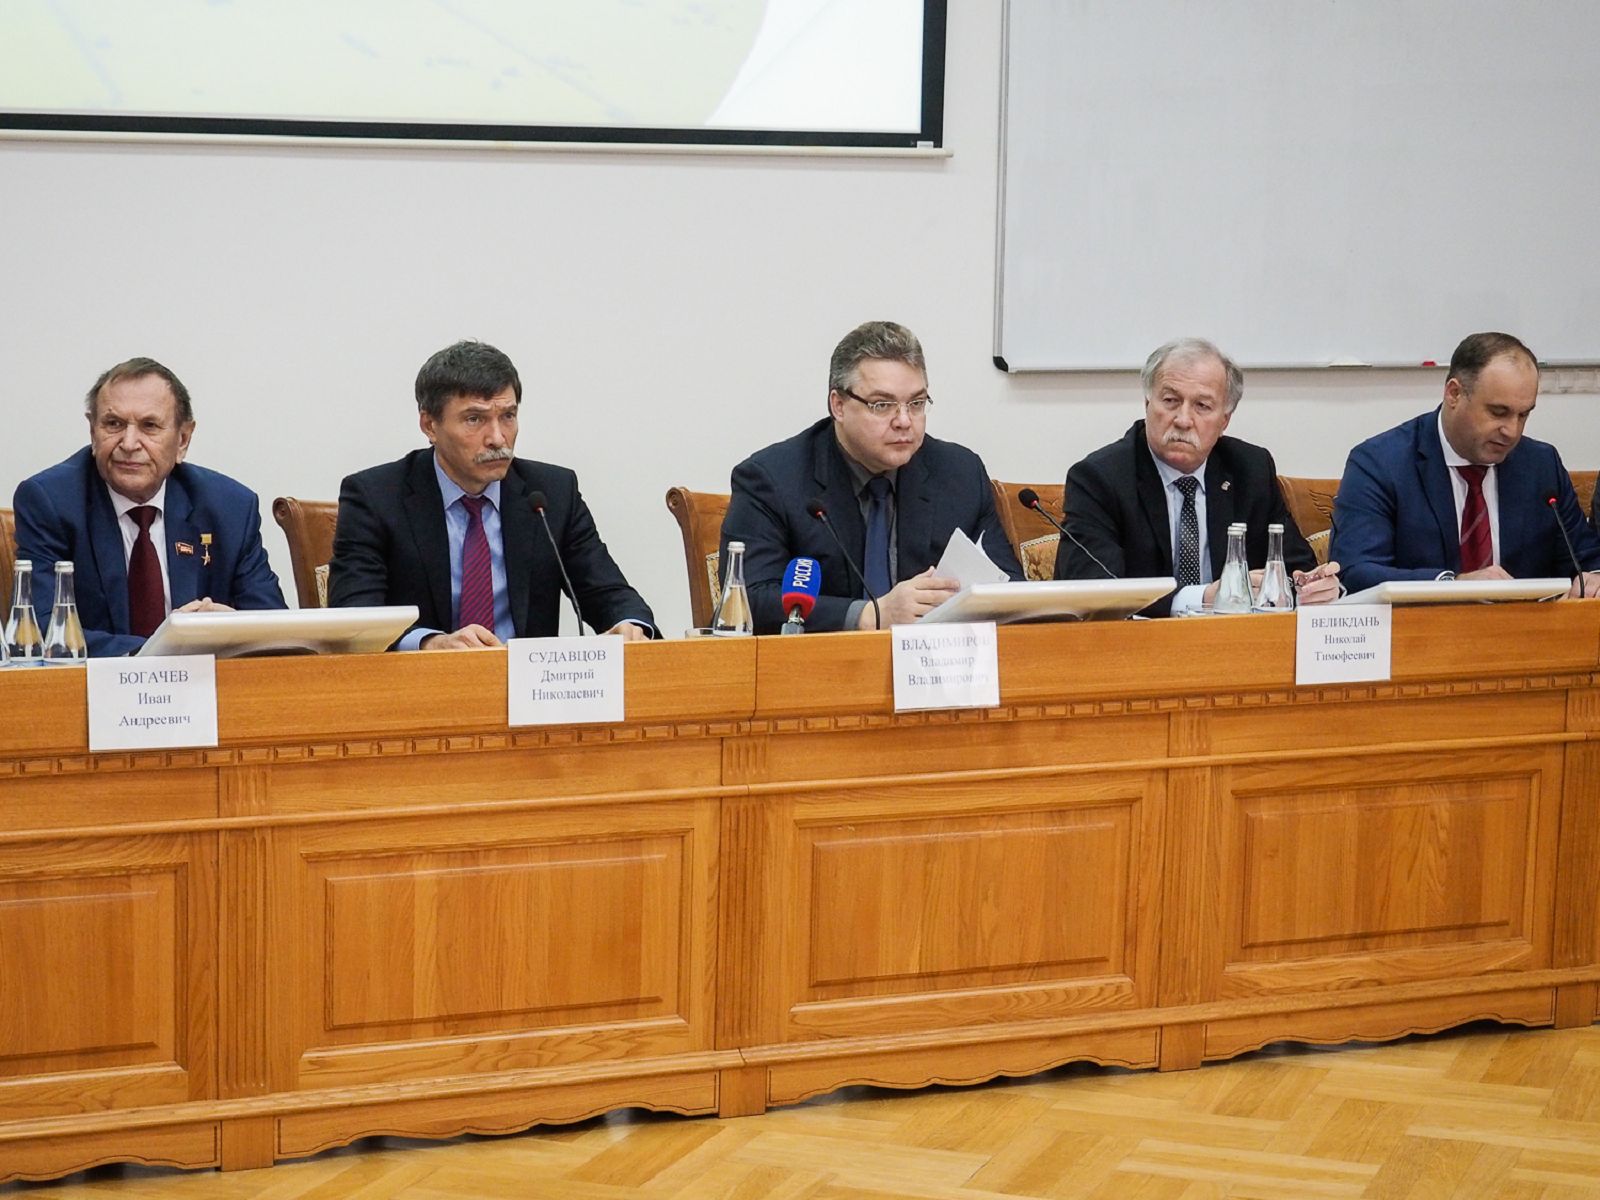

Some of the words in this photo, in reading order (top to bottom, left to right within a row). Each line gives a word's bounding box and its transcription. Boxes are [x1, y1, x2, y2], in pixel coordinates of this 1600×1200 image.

[1311, 616, 1380, 628] ВЕЛИКДАНЬ
[1324, 634, 1366, 644] Николай
[528, 650, 607, 664] СУДАВЦОВ
[1314, 650, 1376, 663] Тимофеевич
[118, 670, 189, 685] БОГАЧЕВ
[540, 668, 595, 683] Дмитрий
[138, 692, 172, 705] Иван
[532, 688, 604, 701] Николаевич
[118, 715, 191, 729] Андреевич
